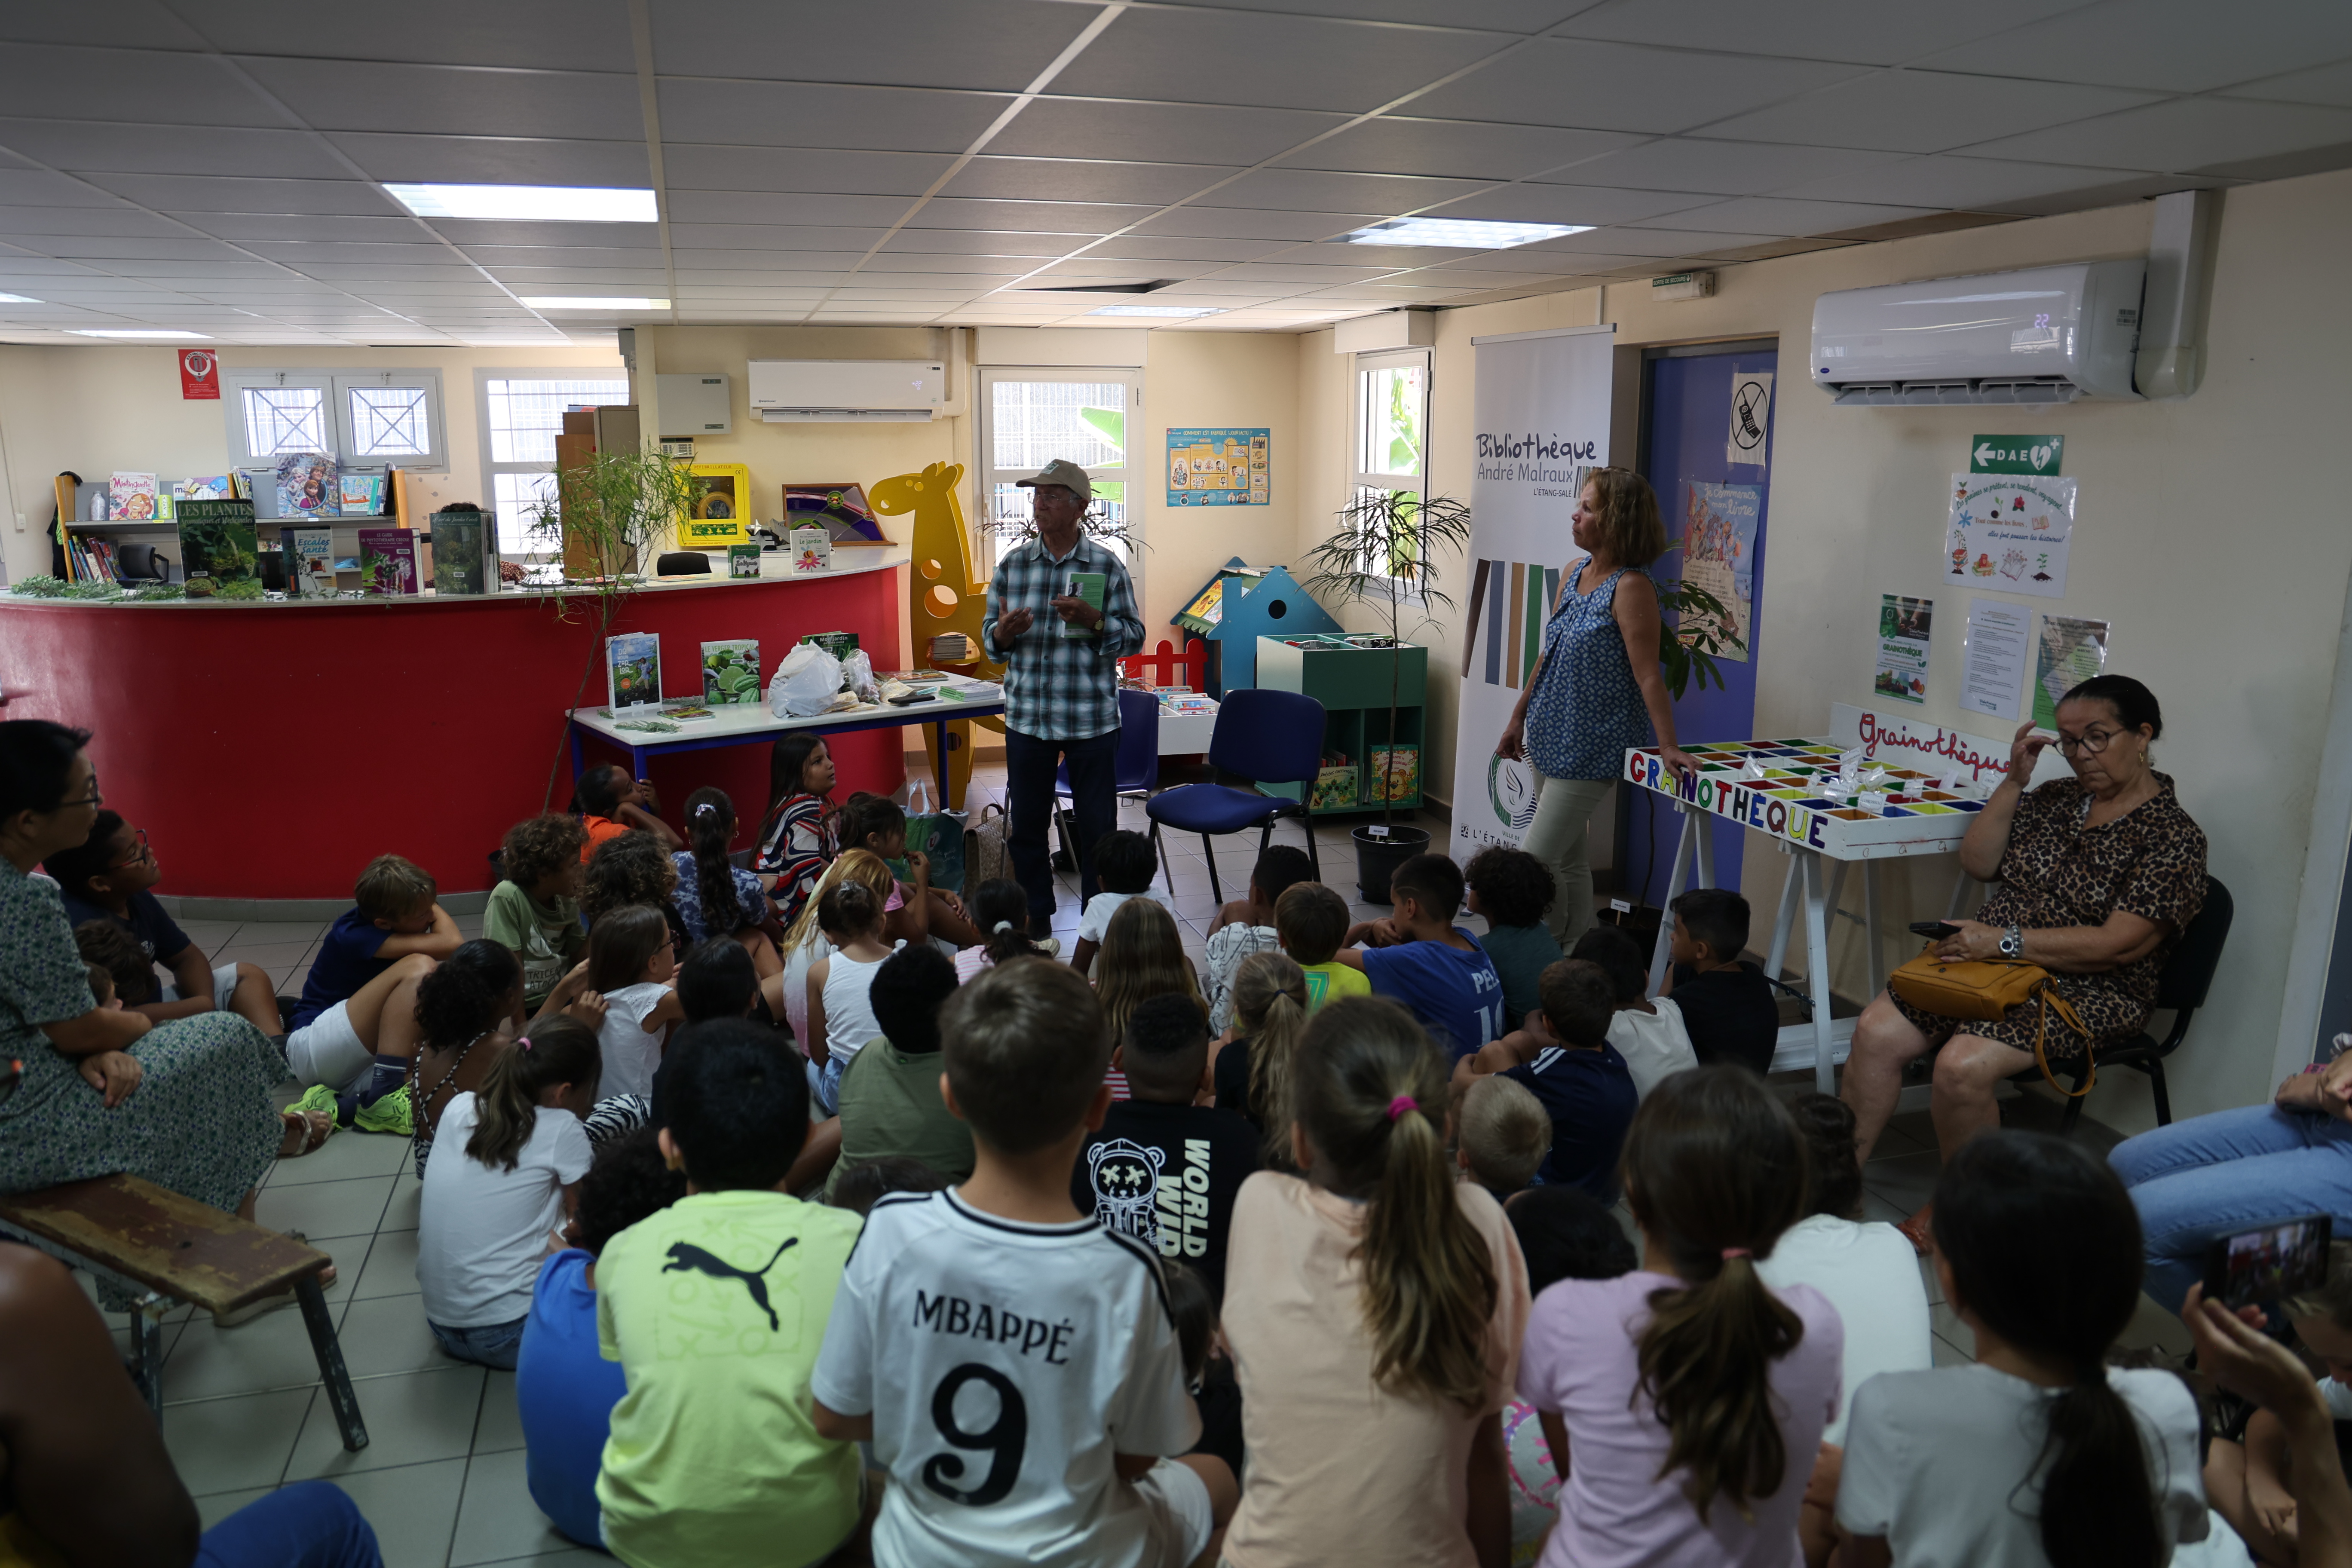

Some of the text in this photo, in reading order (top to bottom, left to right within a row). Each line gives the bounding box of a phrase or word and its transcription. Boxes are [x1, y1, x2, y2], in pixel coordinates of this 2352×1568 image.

[2035, 314, 2050, 328] 22
[186, 352, 209, 360] EXTINCTEUR
[1476, 432, 1597, 467] Bibliothèque
[1997, 449, 2028, 461] DAE
[1477, 461, 1573, 483] André Malraux
[112, 476, 151, 491] Mistinguette
[1533, 487, 1572, 497] L'ÉTANG-SALÉ
[1713, 488, 1757, 500] commence
[1964, 488, 1982, 505] graines
[2017, 482, 2037, 496] rendent,
[177, 504, 199, 516] LES
[201, 502, 253, 516] PLANTES
[1726, 498, 1755, 516] livre
[181, 517, 214, 525] Aromatiques
[297, 537, 330, 546] Escales
[1999, 532, 2009, 541] font
[302, 545, 328, 554] Santé
[1883, 643, 1923, 657] GRAINOTHÈQUE
[1502, 830, 1514, 839] VILLE
[929, 836, 937, 848] U
[1182, 1139, 1210, 1258] WORLD
[912, 1288, 1074, 1366] MBAPPÉ
[922, 1362, 1028, 1508] 9
